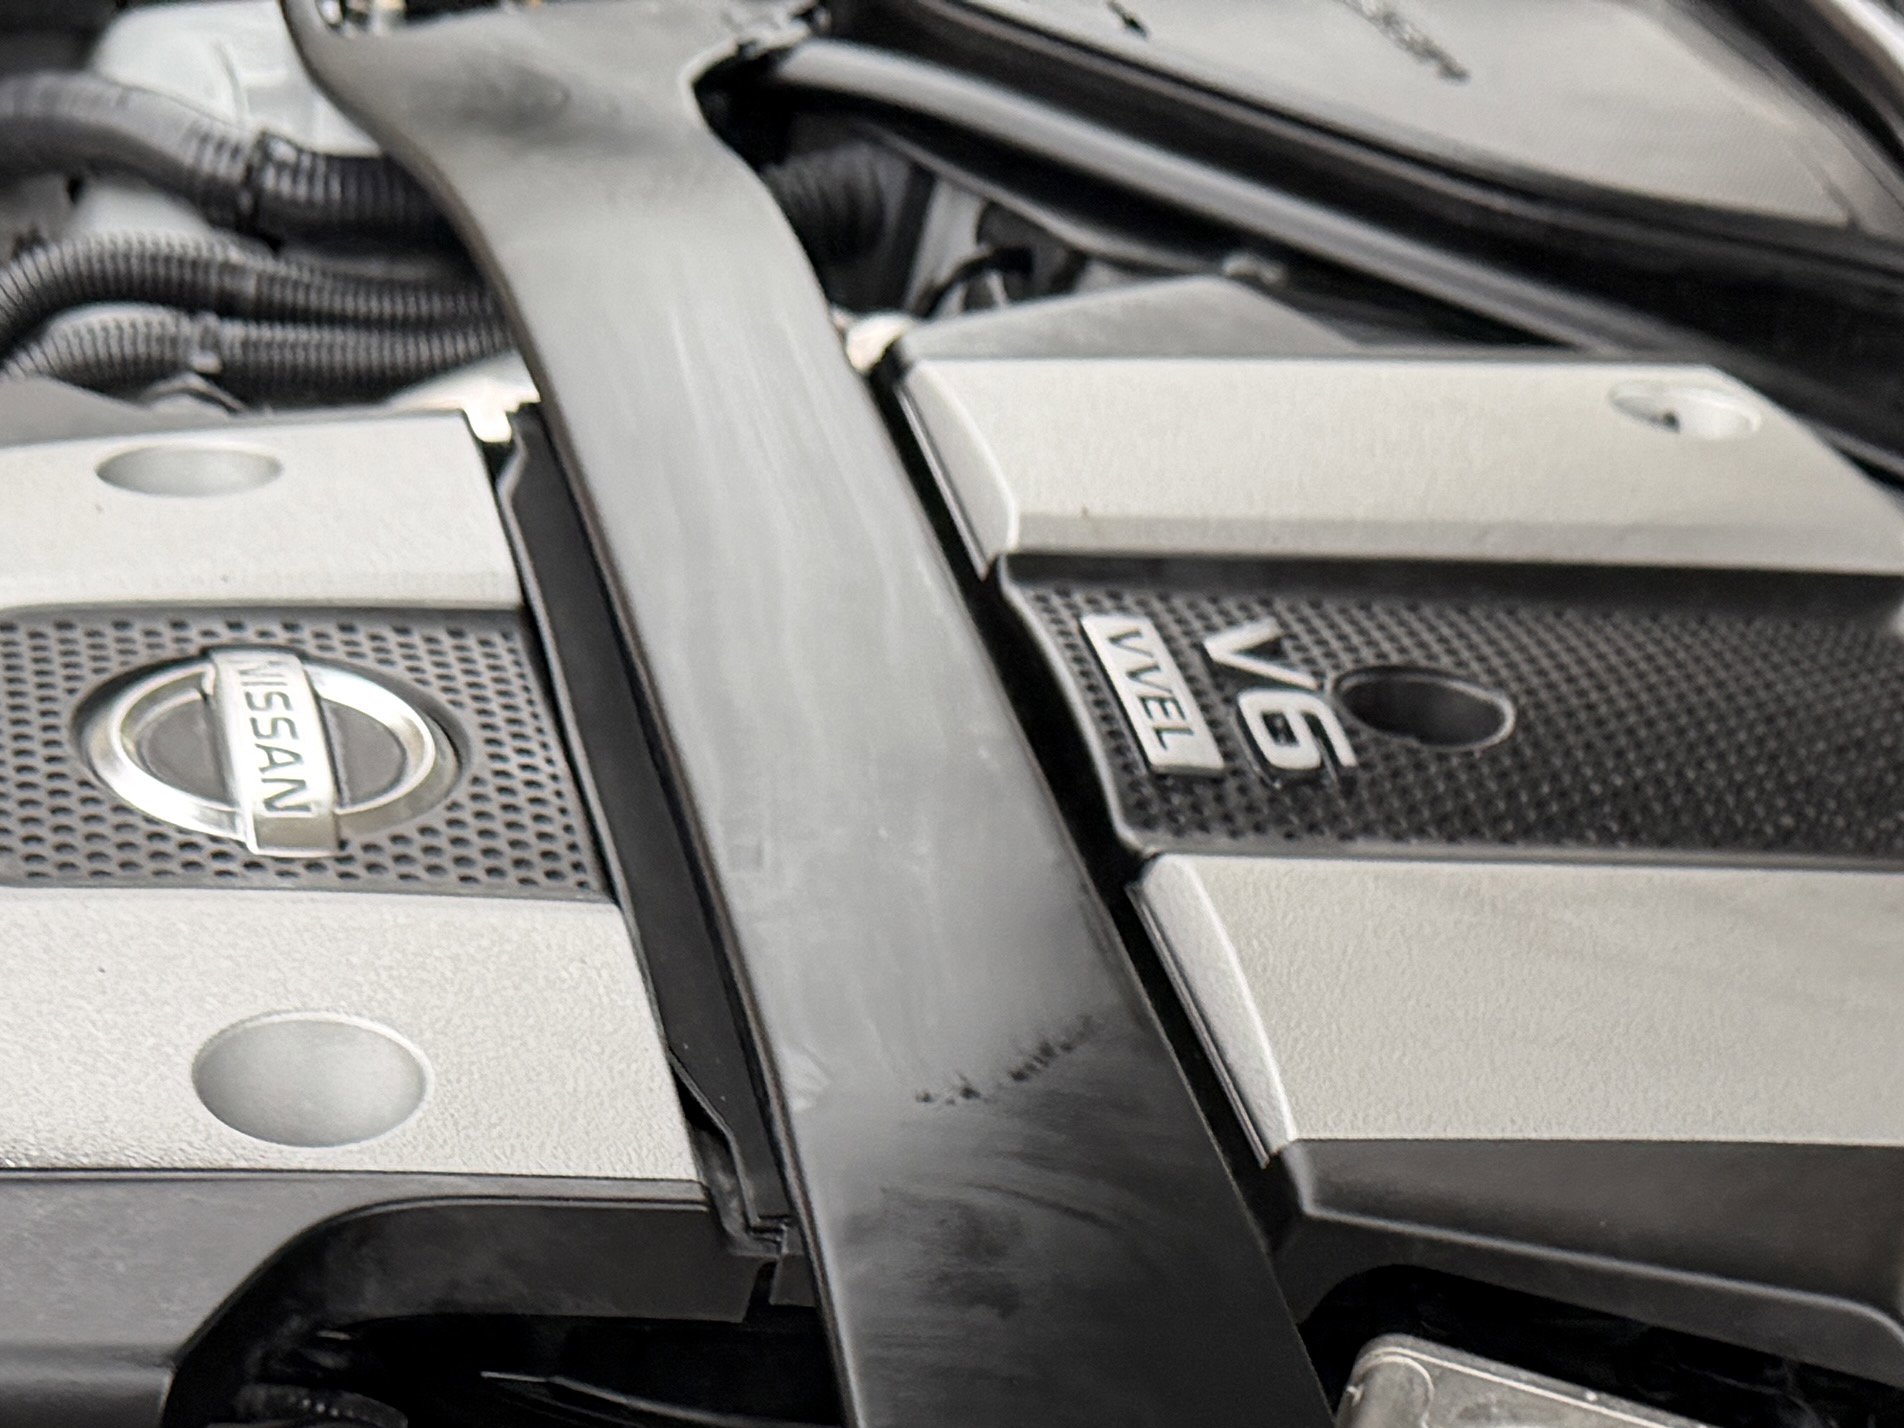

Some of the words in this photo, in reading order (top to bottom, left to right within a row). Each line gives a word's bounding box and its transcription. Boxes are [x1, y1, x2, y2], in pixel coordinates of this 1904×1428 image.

[232, 656, 312, 815] NISSAN
[1106, 628, 1194, 751] VVEL
[1203, 617, 1358, 770] V6
